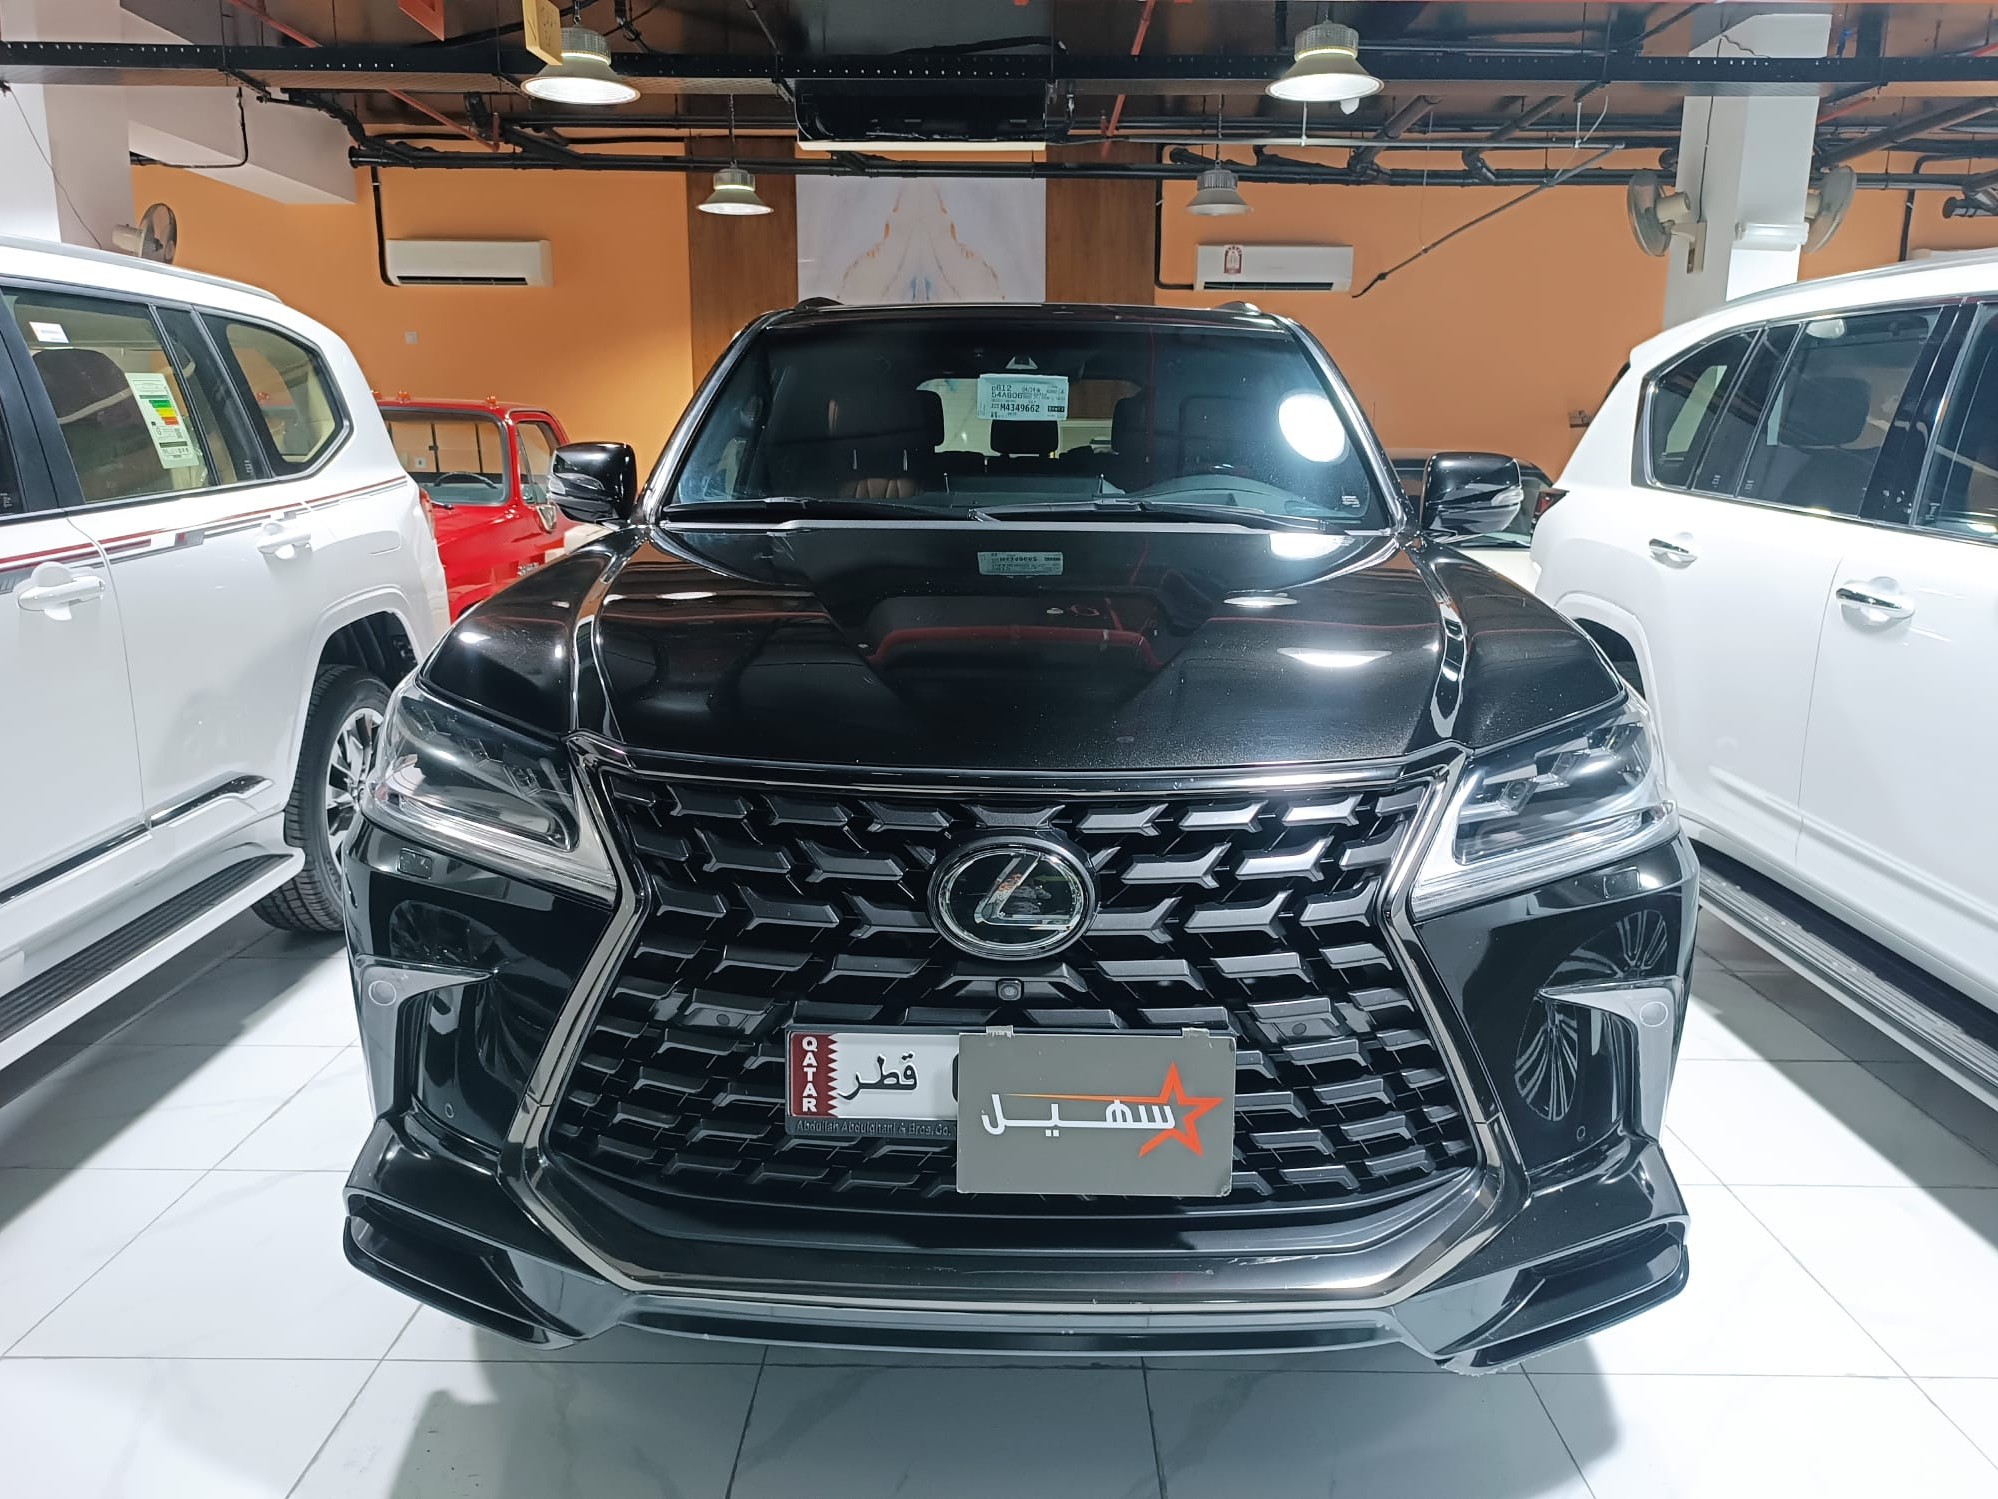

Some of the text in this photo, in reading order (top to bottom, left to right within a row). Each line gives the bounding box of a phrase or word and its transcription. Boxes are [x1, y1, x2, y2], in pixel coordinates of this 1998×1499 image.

[802, 1036, 818, 1112] QATAR
[837, 1052, 918, 1101] قطر
[797, 1120, 838, 1132] Abdullah
[981, 1094, 1176, 1137] سهيل
